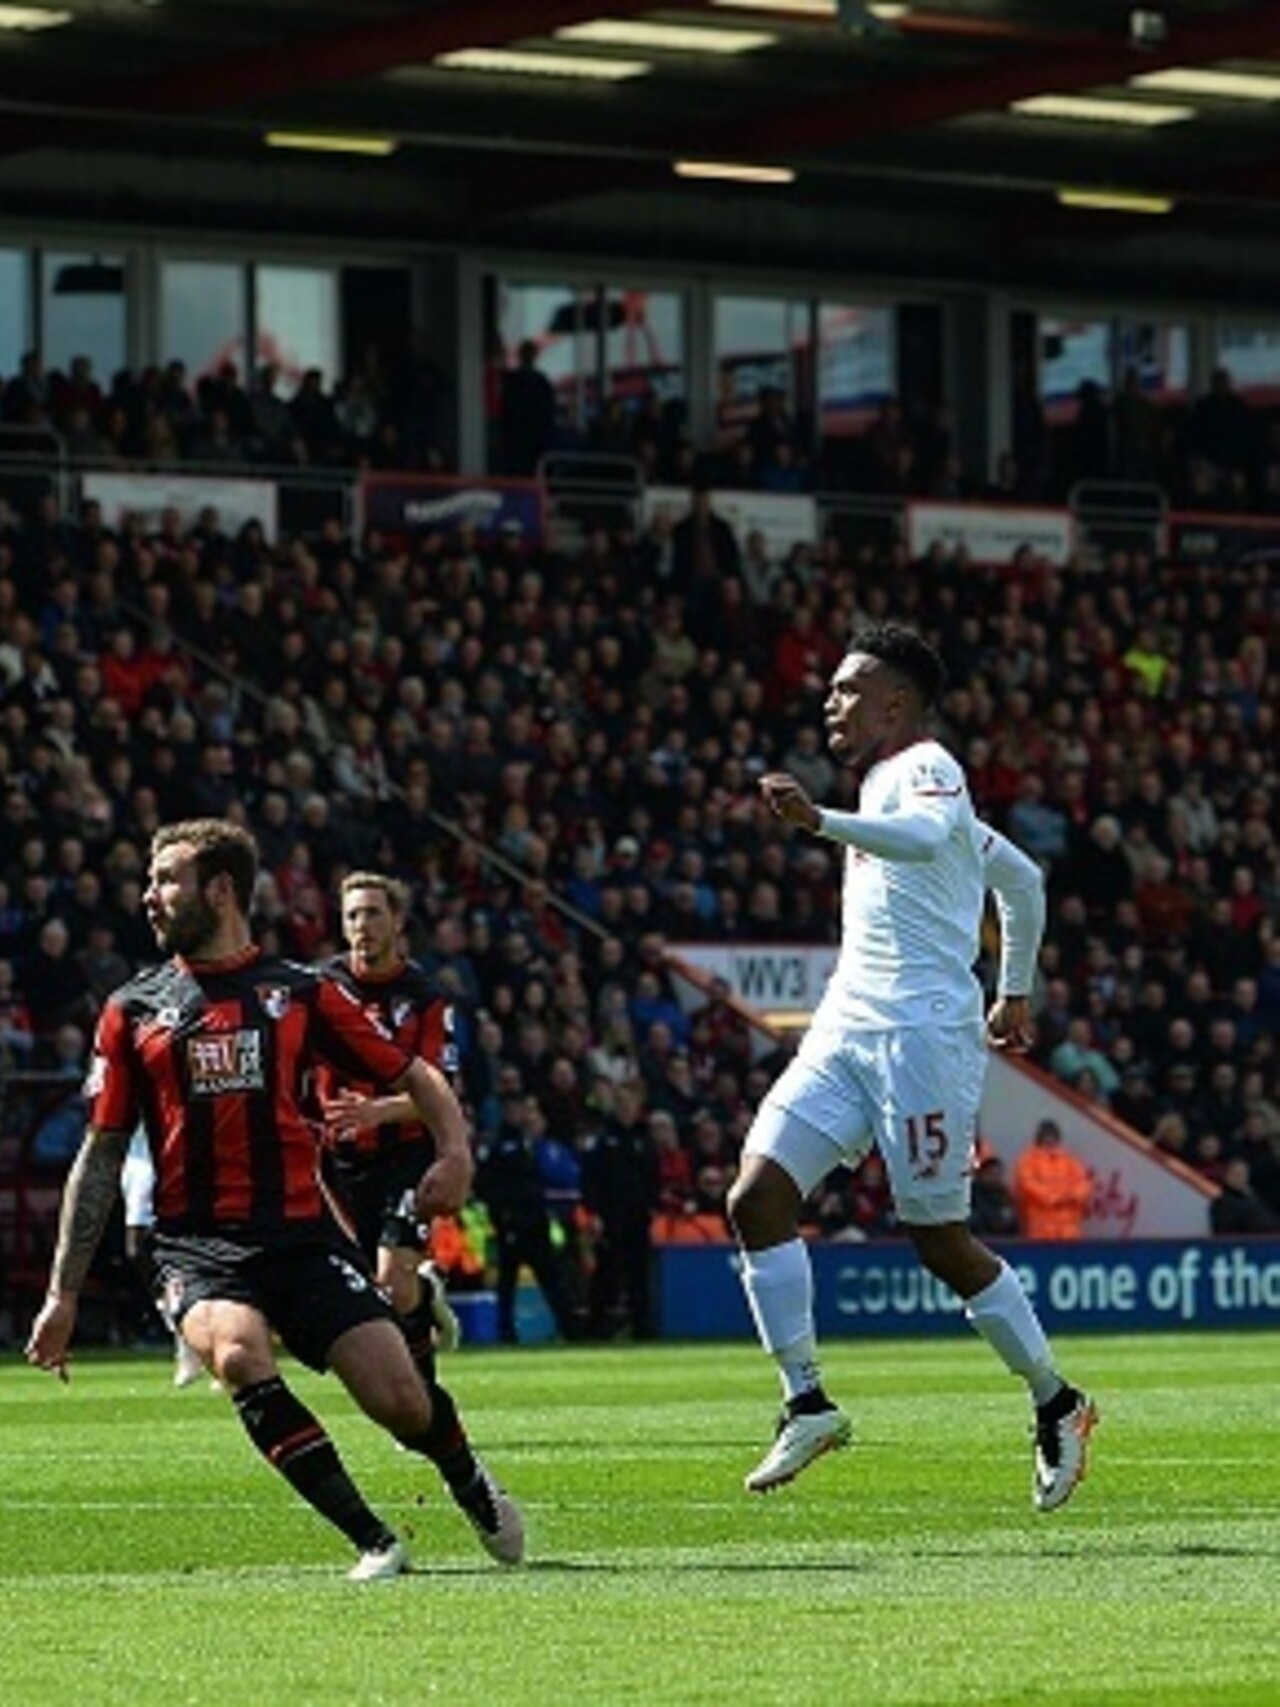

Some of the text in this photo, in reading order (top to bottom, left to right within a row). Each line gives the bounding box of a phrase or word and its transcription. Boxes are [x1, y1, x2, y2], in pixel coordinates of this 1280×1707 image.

[737, 954, 808, 998] WV3
[904, 1108, 949, 1165] 15
[1048, 1264, 1138, 1311] one
[1148, 1247, 1201, 1319] of
